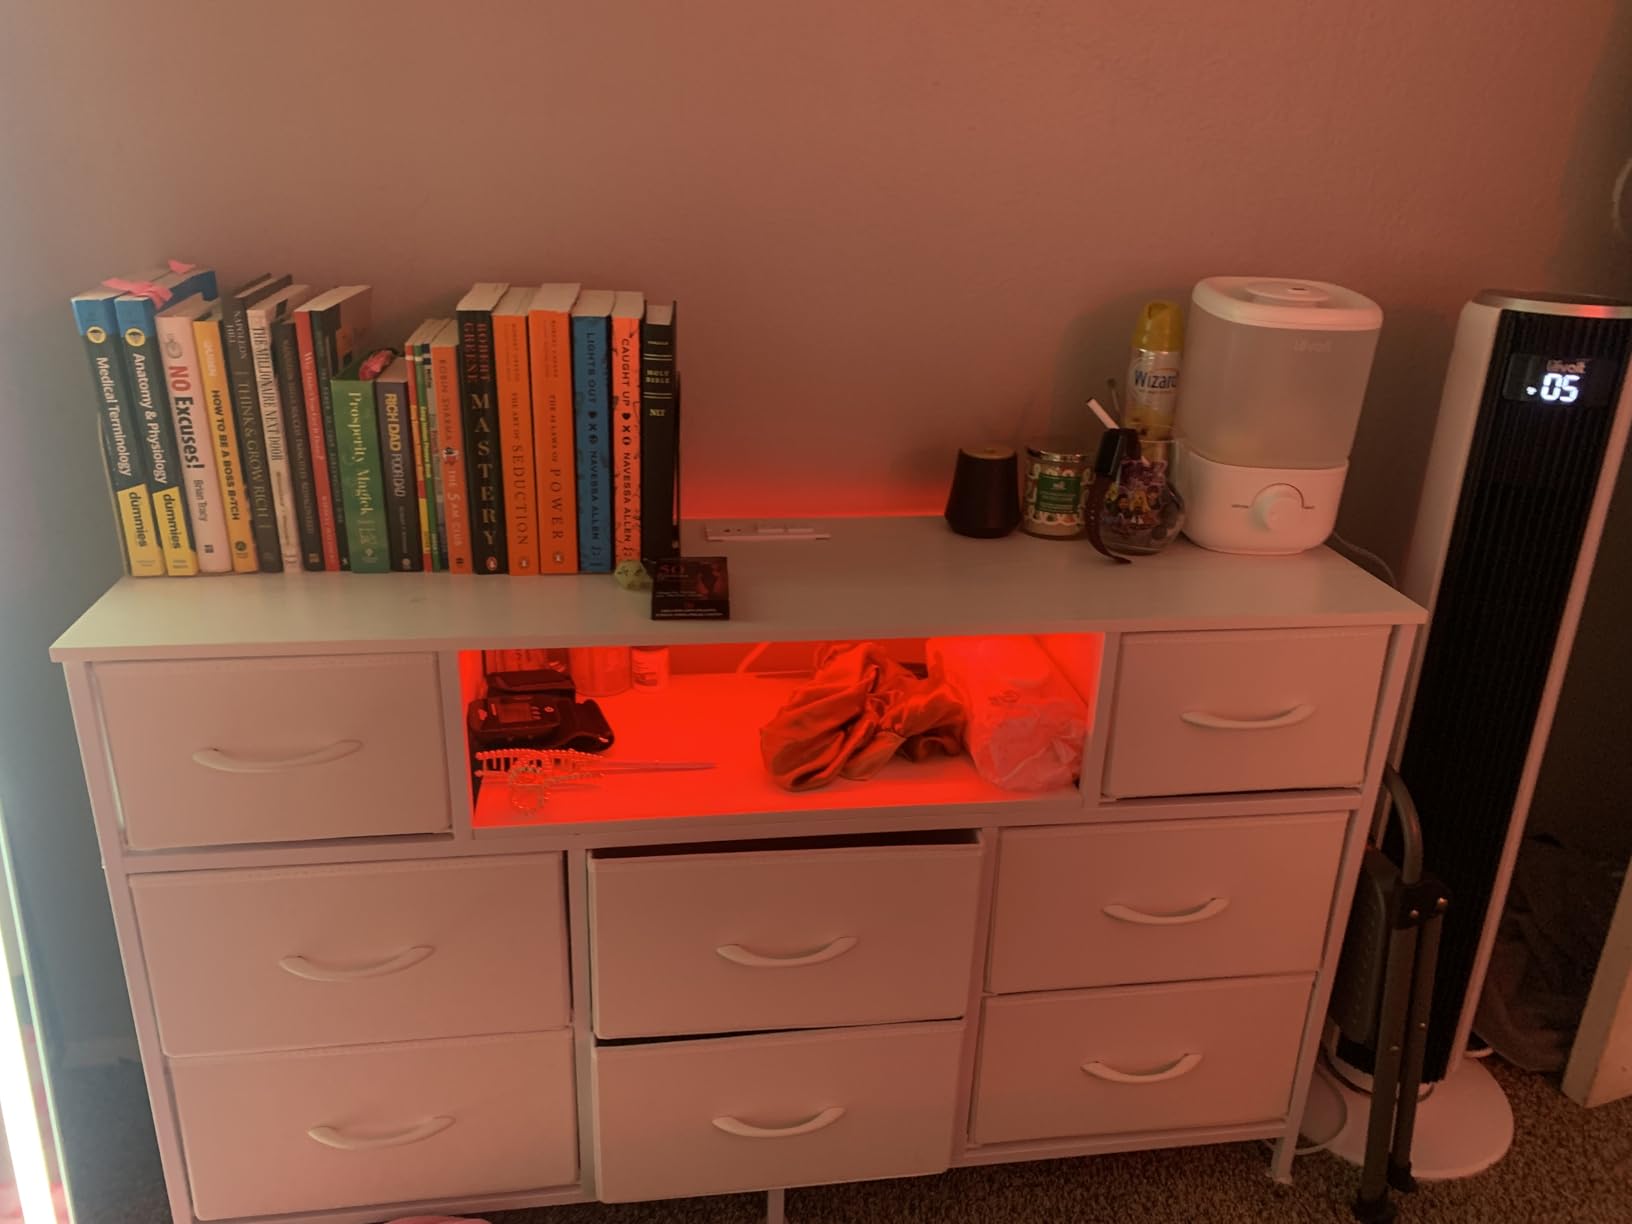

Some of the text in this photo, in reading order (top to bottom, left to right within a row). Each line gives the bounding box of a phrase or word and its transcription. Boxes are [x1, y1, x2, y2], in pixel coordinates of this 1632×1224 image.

[464, 322, 477, 382] GREENE
[476, 323, 490, 381] ROBERT
[586, 332, 597, 376] LIGHTS
[621, 338, 631, 386] CAUGHT
[255, 348, 275, 407] MILLIONAIRE
[587, 379, 598, 403] OUT
[622, 391, 631, 406] UP
[96, 357, 132, 476] Medical Terminology
[132, 353, 168, 484] Anatomy & Physiology
[168, 366, 205, 468] NO Excuses!
[211, 390, 224, 415] HOW
[238, 384, 255, 426] THINK
[384, 393, 399, 422] RICH
[215, 418, 226, 432] TO
[218, 434, 229, 447] BE
[347, 392, 367, 462] Prosperity
[388, 423, 401, 451] DAD
[223, 460, 235, 488] BOSS
[247, 440, 264, 480] GROW
[471, 393, 496, 545] MASTERY
[254, 486, 269, 517] RICH
[512, 444, 528, 545] SEDUCTION
[550, 468, 563, 540] POWER
[129, 492, 148, 547] dummies
[163, 494, 181, 549] dummies
[591, 506, 601, 540] ALLEN
[624, 508, 633, 542] ALLEN
